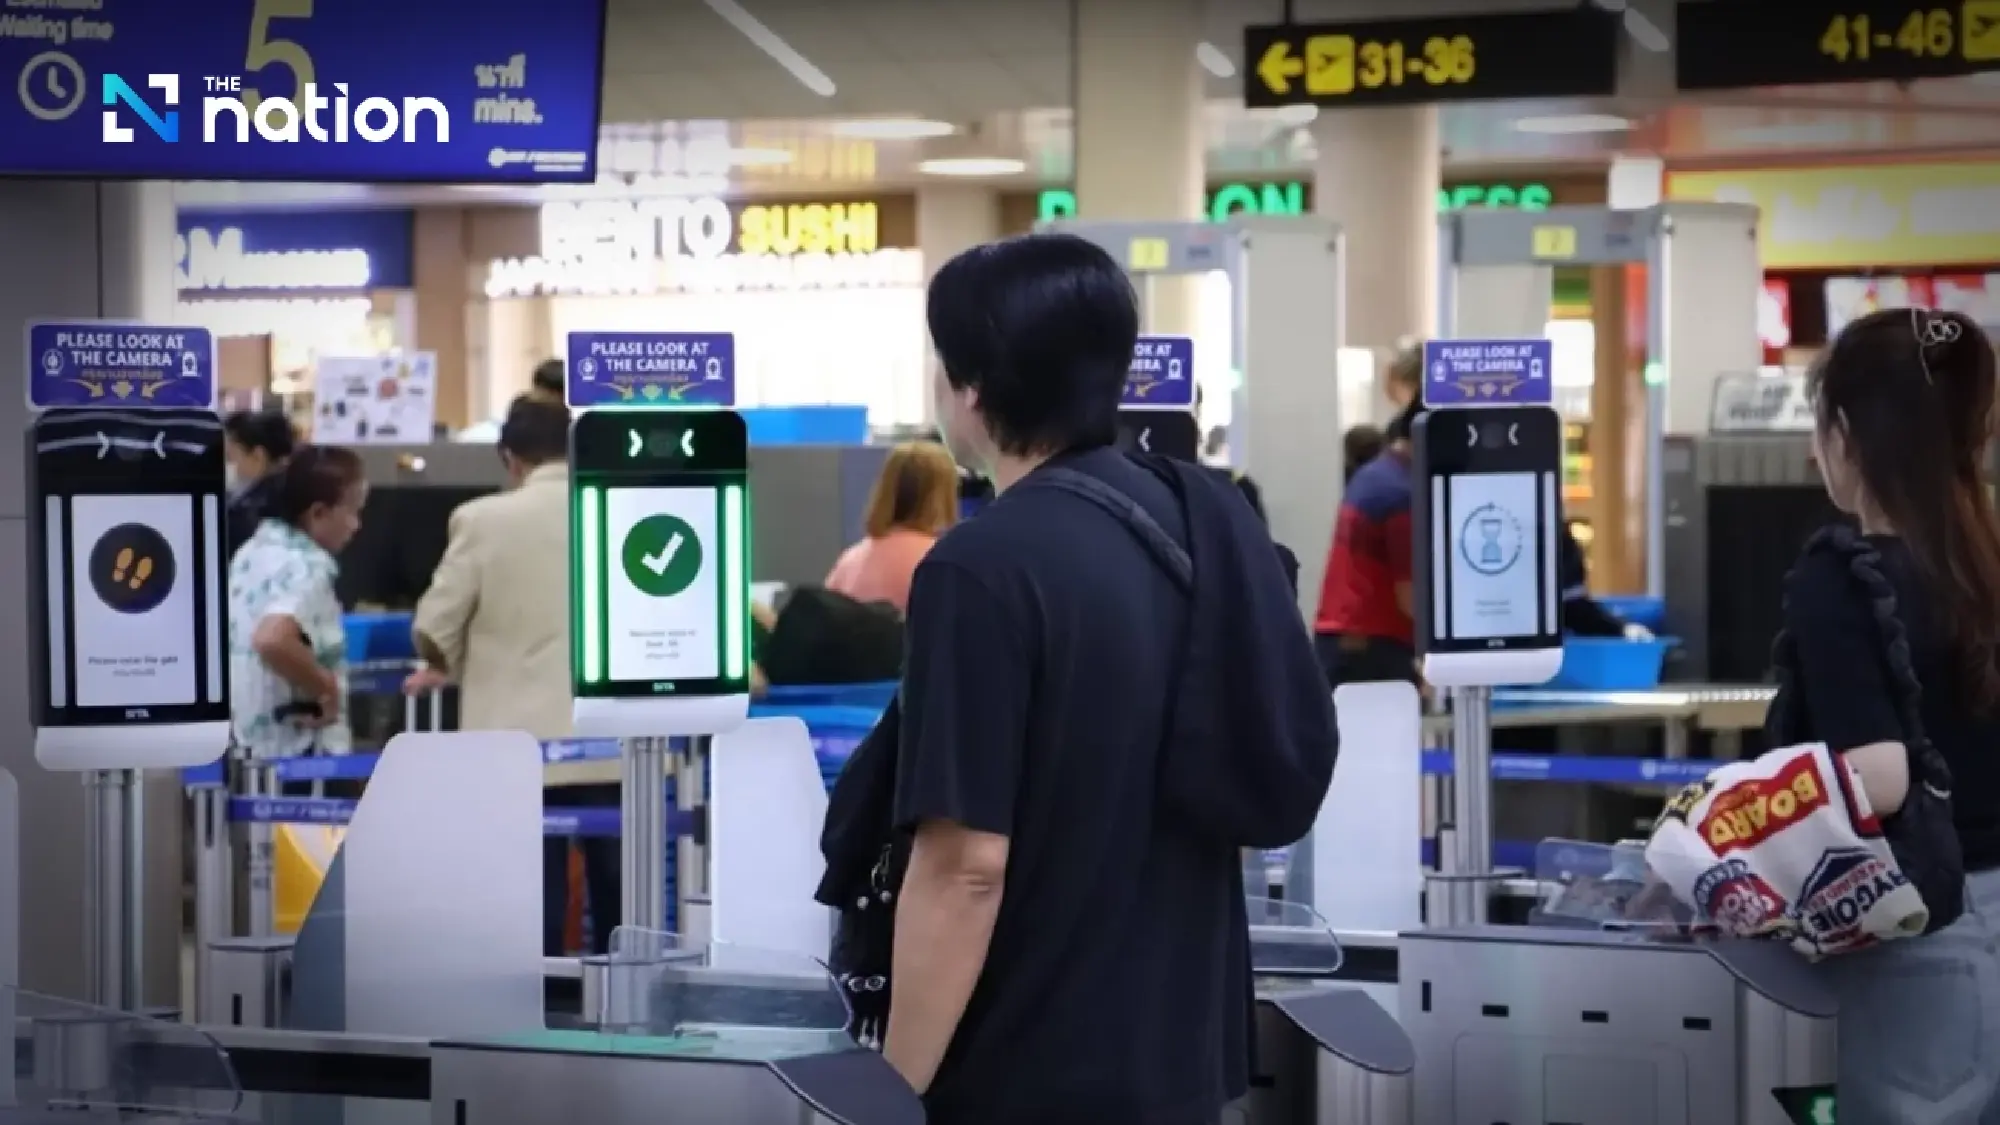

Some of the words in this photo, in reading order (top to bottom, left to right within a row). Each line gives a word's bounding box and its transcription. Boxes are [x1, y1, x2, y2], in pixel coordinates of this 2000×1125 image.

[71, 16, 113, 39] time
[1819, 9, 1951, 61] 41-46
[1358, 35, 1476, 88] 31-36
[473, 92, 543, 124] mins.
[739, 201, 879, 254] SUSHI
[57, 333, 113, 348] PLEASE
[117, 334, 162, 349] LOOK
[165, 334, 185, 349] AT
[591, 342, 643, 356] PLEASE
[647, 342, 688, 356] LOOK
[691, 342, 709, 356] AT
[1134, 343, 1153, 357] OK
[1156, 343, 1172, 357] AT
[1441, 346, 1480, 360] PLEASE
[1484, 346, 1516, 358] LOOK
[1518, 345, 1532, 357] AT
[71, 351, 102, 365] THE
[105, 351, 172, 366] CAMERA
[605, 358, 632, 372] THE
[636, 358, 697, 372] CAMERA
[1452, 360, 1473, 372] THE
[1476, 360, 1525, 372] CAMERA
[1708, 769, 1821, 848] BOARD
